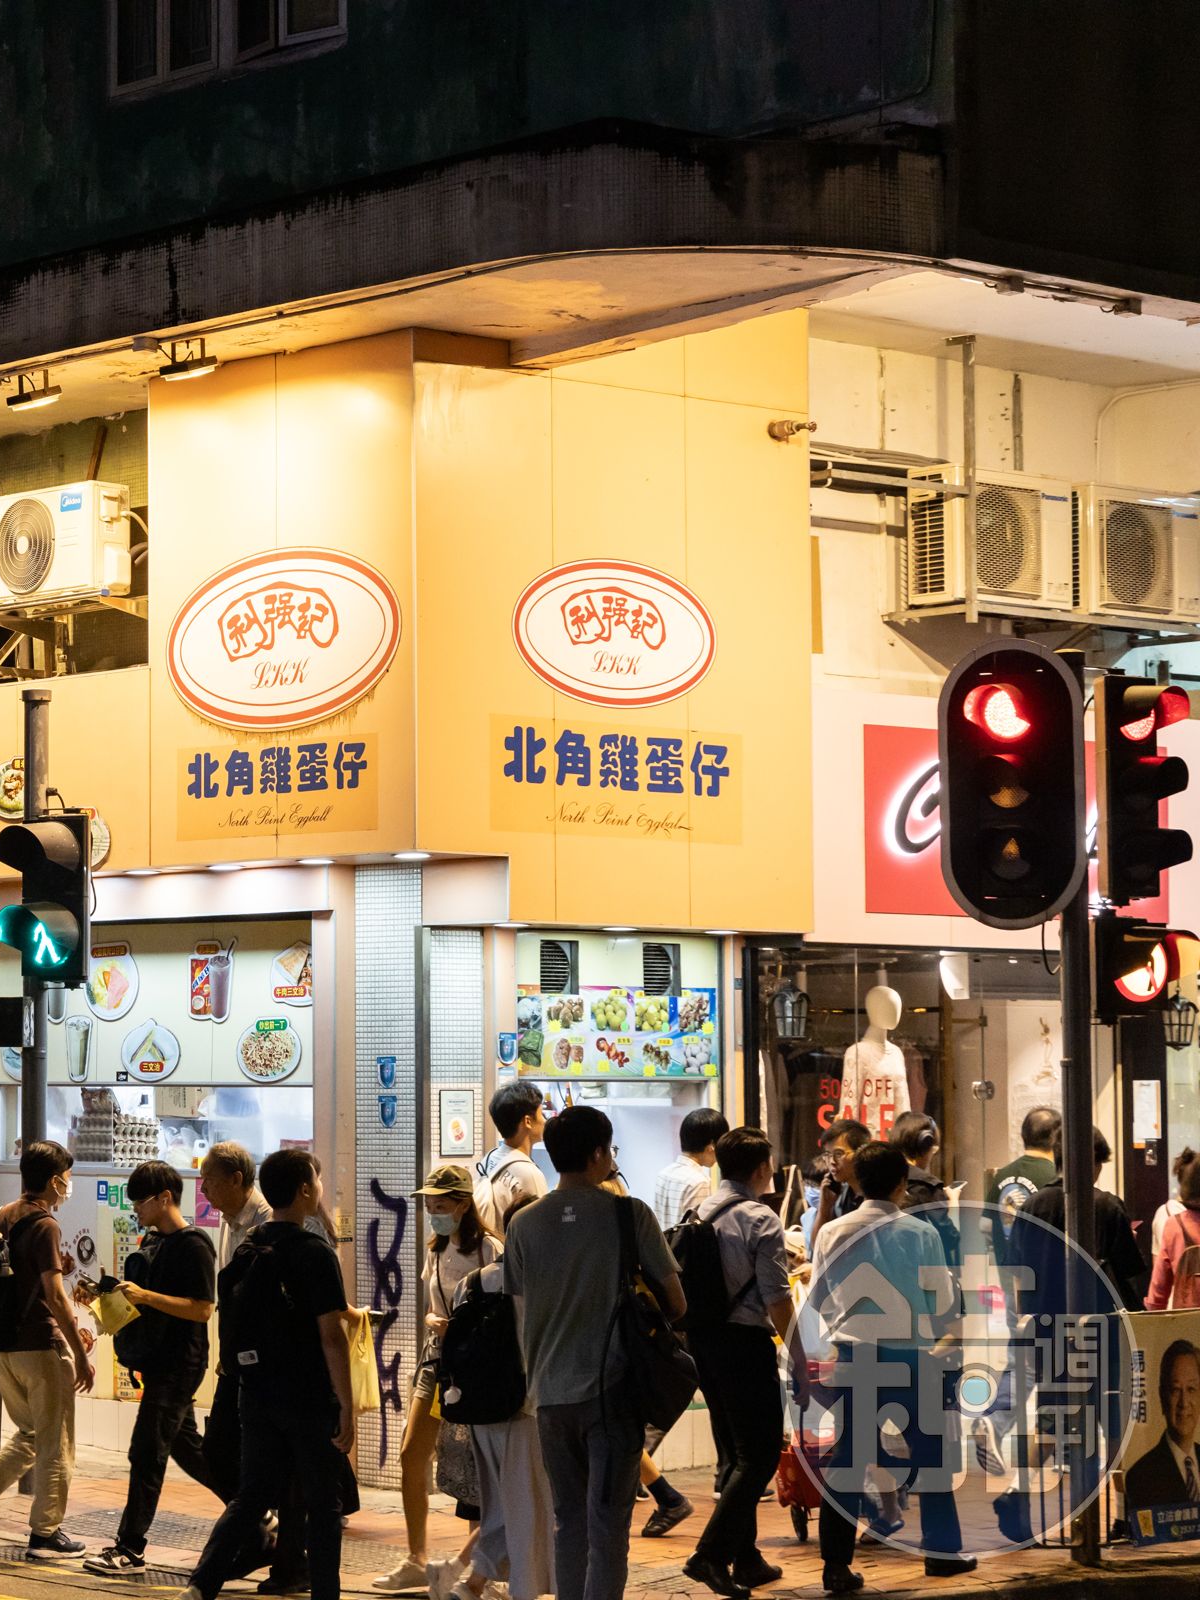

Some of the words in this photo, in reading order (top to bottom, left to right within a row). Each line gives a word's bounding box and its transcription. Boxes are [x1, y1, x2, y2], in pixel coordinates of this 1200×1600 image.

[186, 741, 368, 800] 北角雞蛋仔
[503, 725, 730, 798] 北角雞蛋仔
[218, 808, 253, 828] North
[254, 805, 287, 826] Point
[288, 802, 334, 830] Eggball
[545, 801, 591, 823] North
[593, 802, 633, 826] Point
[142, 1062, 161, 1072] 三文治
[819, 1078, 854, 1100] 50%
[863, 1078, 893, 1098] OFF
